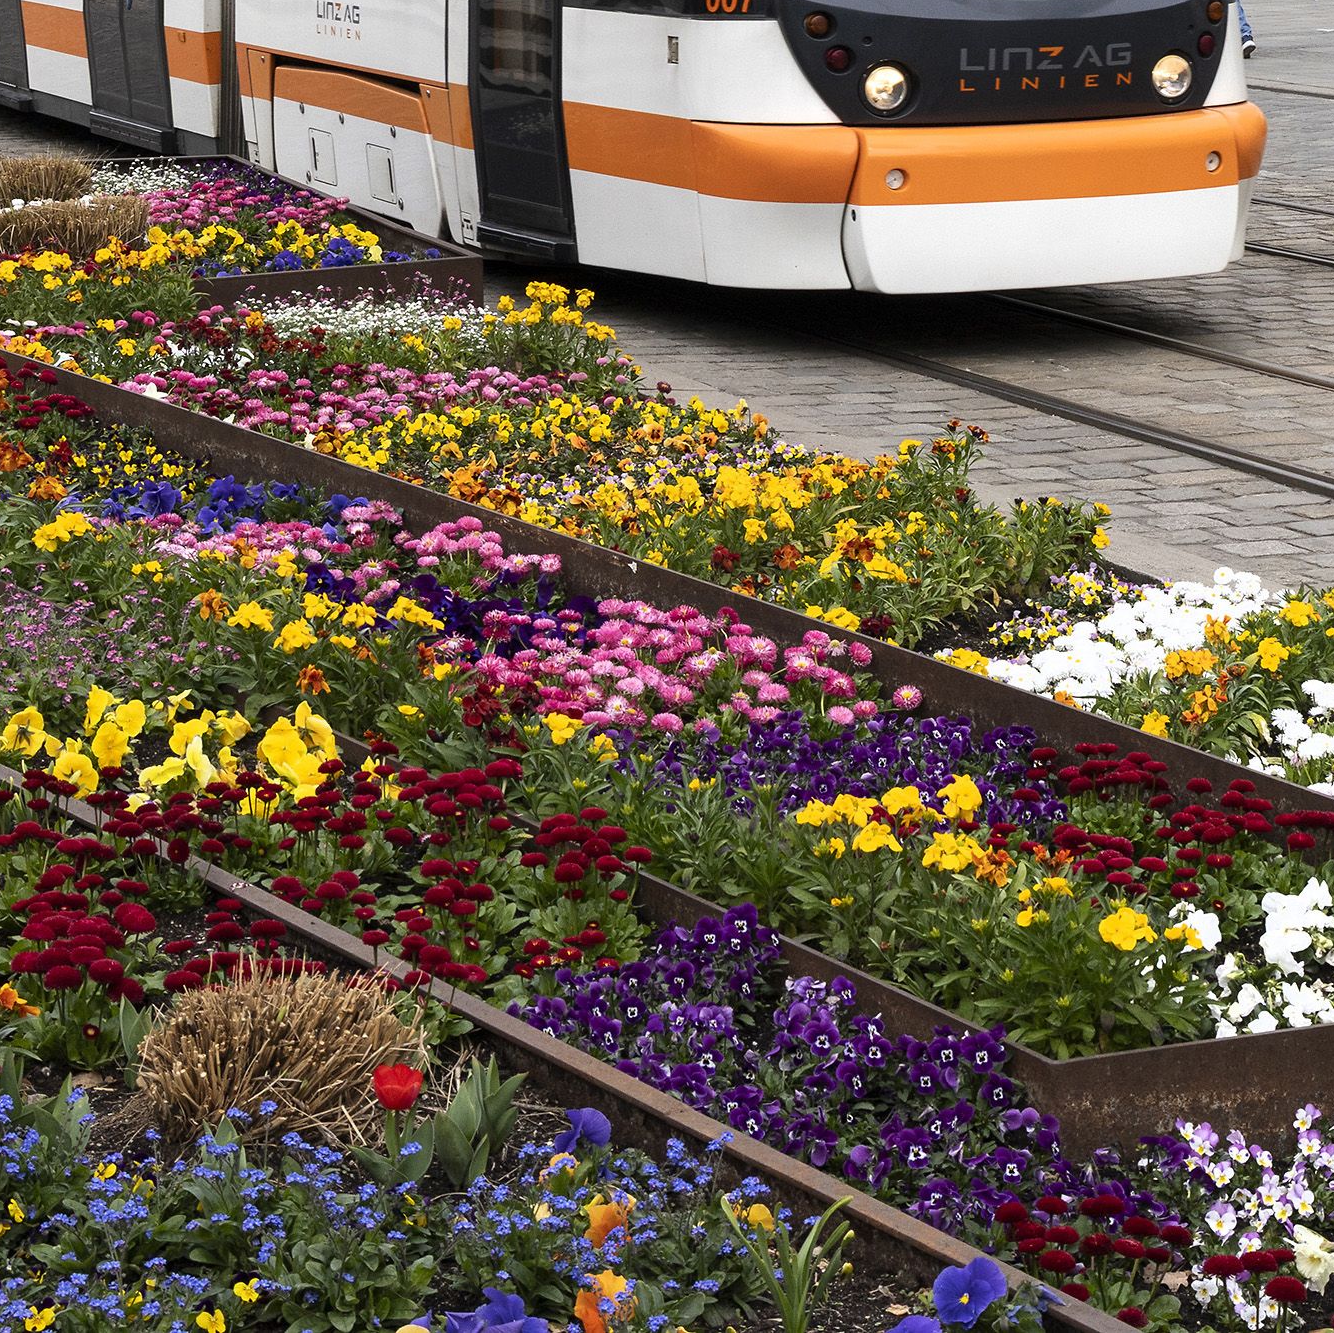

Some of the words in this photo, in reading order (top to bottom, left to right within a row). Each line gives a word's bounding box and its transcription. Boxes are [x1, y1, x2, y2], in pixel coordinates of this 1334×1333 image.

[316, 0, 342, 21] LINZ
[344, 4, 360, 24] AG
[316, 24, 361, 41] LINIEN
[959, 46, 1065, 71] LINZ
[1073, 42, 1132, 69] AG
[959, 71, 1133, 92] LINIEN
